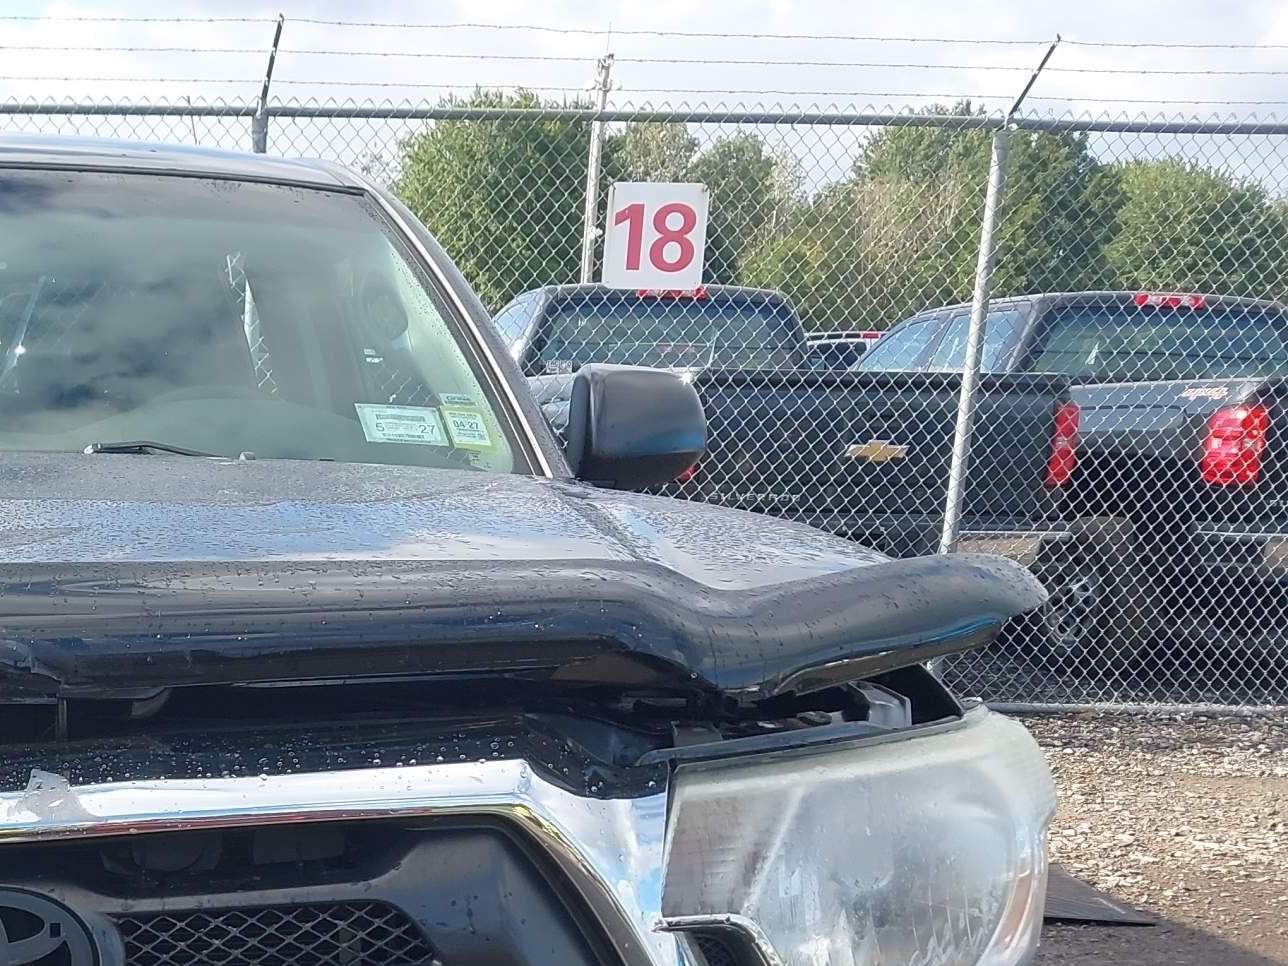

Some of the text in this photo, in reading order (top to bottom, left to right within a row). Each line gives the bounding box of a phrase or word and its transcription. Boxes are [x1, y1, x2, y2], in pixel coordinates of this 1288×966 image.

[614, 202, 697, 273] 18
[375, 422, 385, 432] 5
[419, 424, 435, 434] 27
